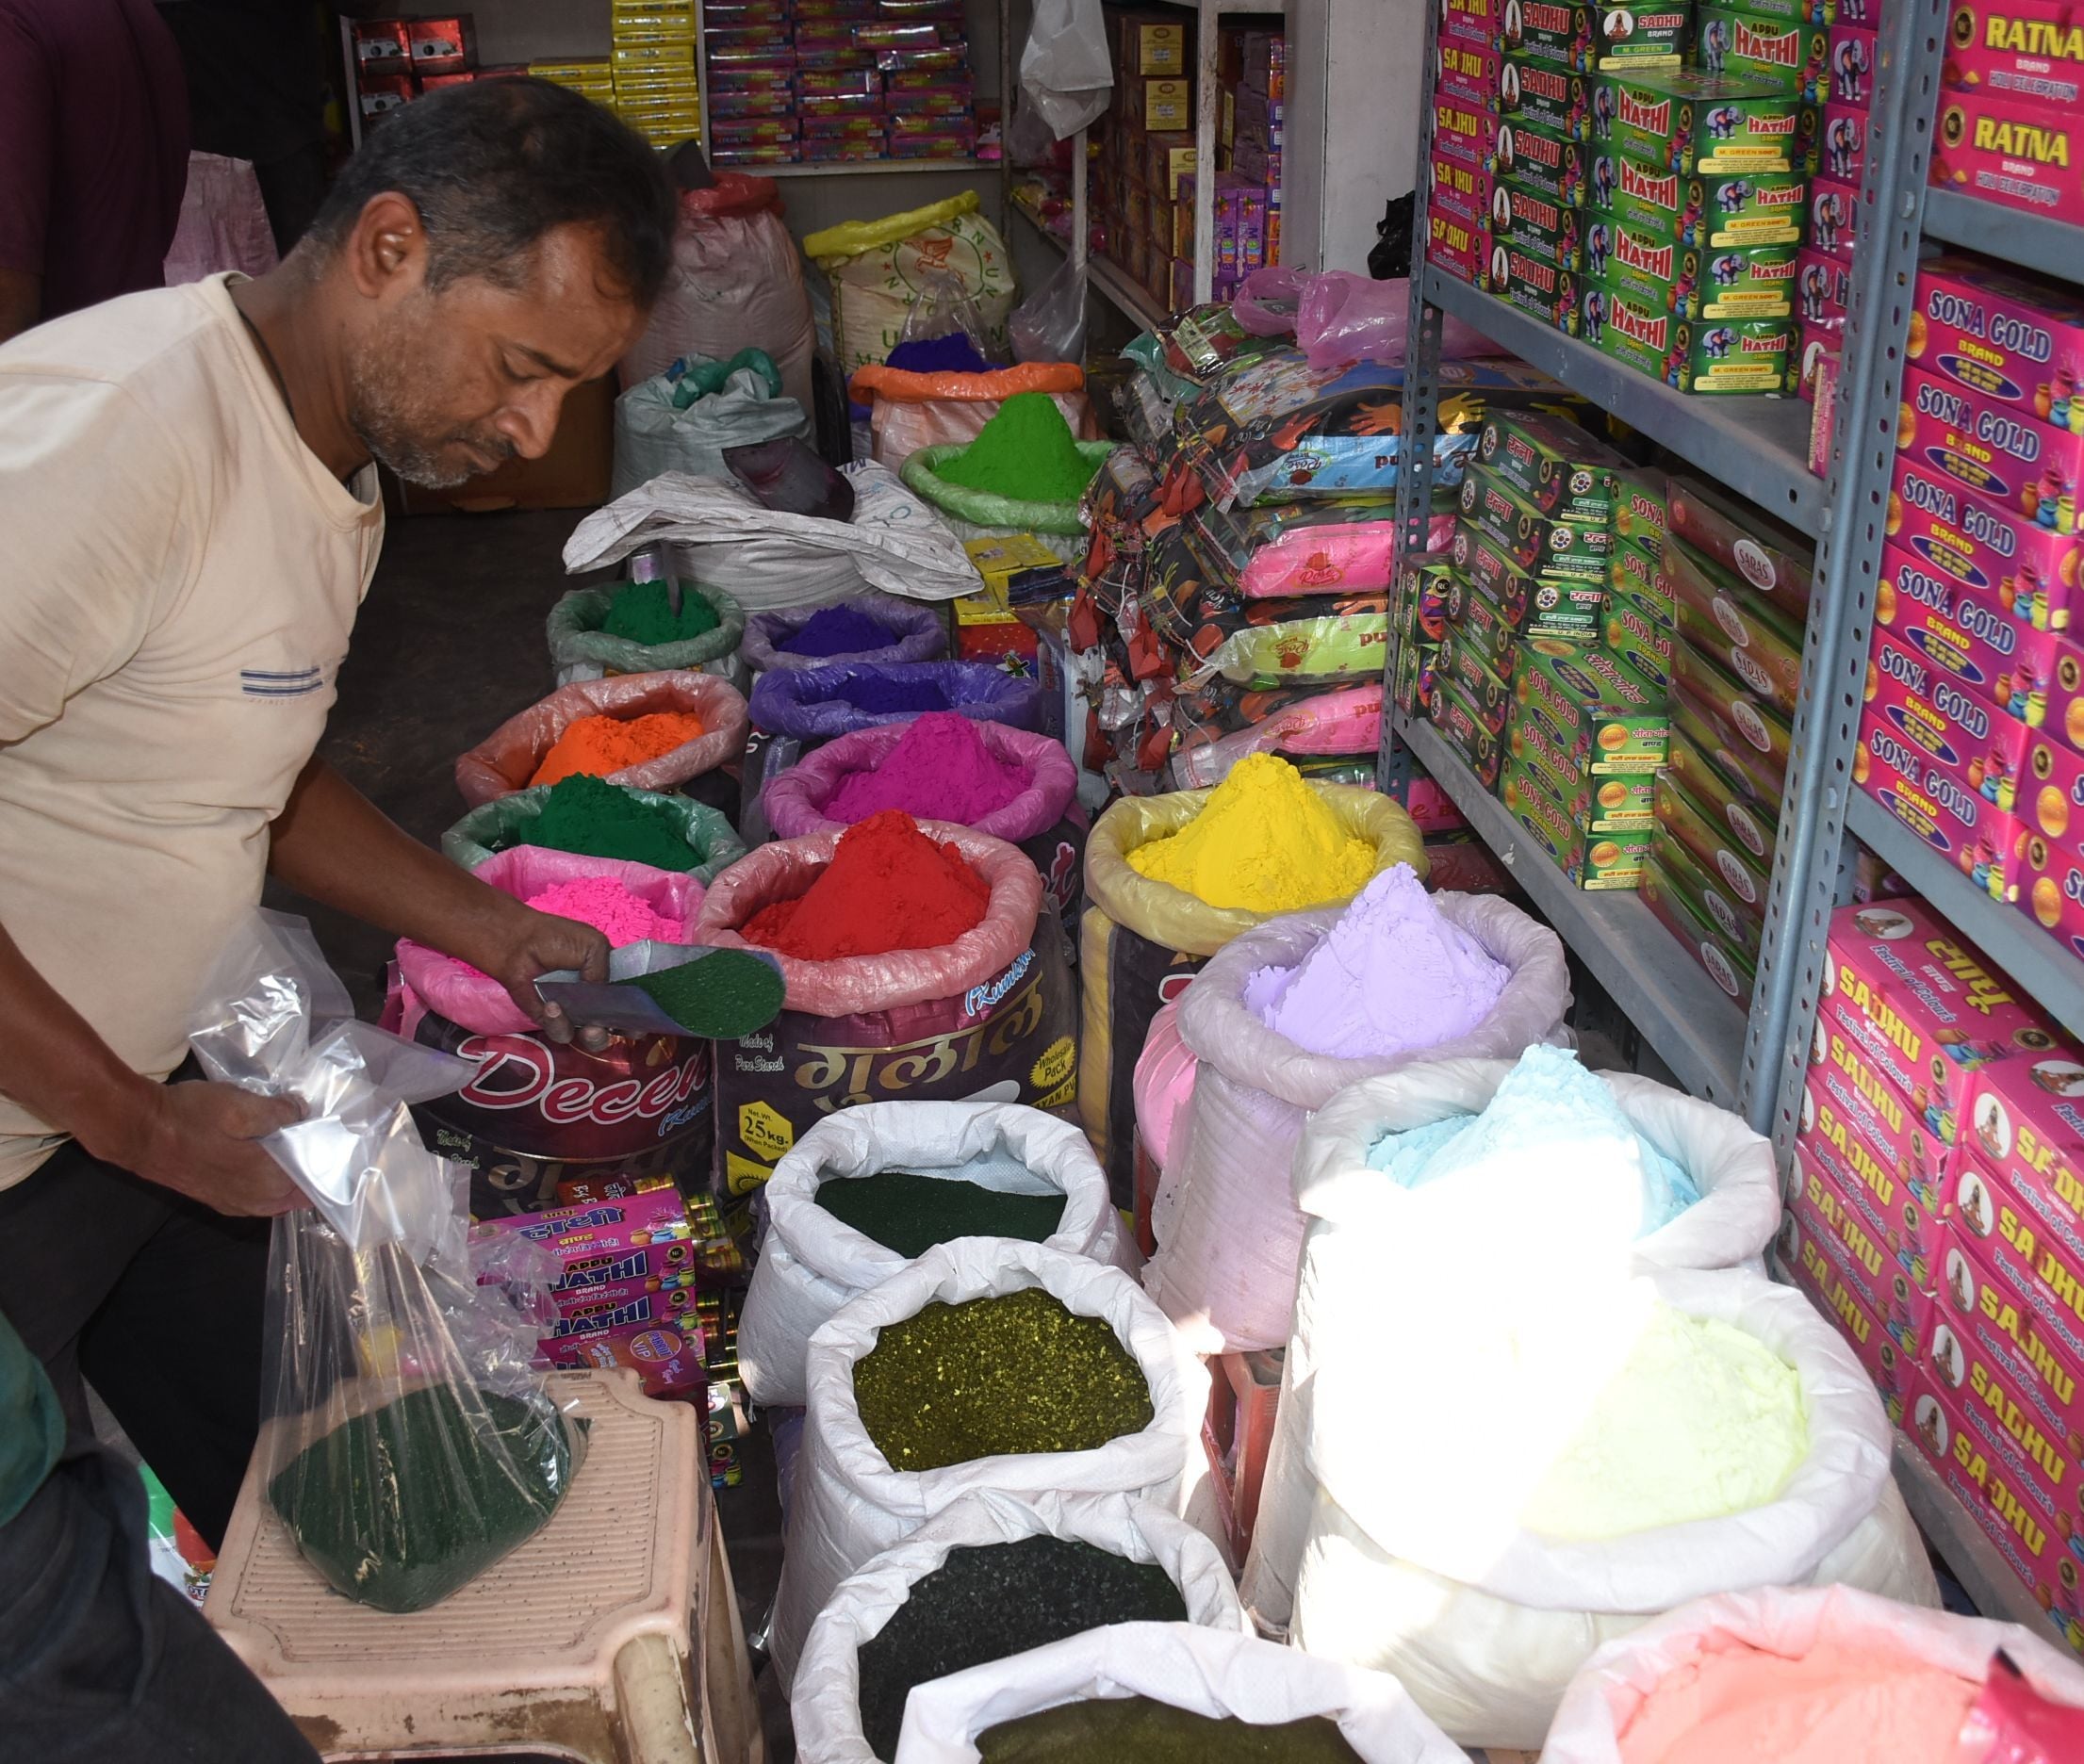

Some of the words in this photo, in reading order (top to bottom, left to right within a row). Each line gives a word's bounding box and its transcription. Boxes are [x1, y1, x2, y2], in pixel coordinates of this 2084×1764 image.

[1523, 2, 1570, 36] SADHU
[1638, 14, 1684, 29] SADHU
[1647, 30, 1674, 39] BRAND
[1733, 18, 1800, 69] HATHI
[1983, 14, 2084, 63] RATNA
[1520, 66, 1567, 103] SADHU
[2015, 58, 2050, 74] BRAND
[1618, 85, 1671, 138] HATHI
[1747, 115, 1796, 135] HATHI
[1514, 129, 1561, 169] SADHU
[1973, 114, 2070, 171] RATNA
[1620, 155, 1678, 212] HATHI
[2000, 160, 2035, 177] BRAND
[1511, 191, 1558, 233] SADHU
[1756, 184, 1804, 206] HATHI
[1615, 224, 1673, 282] HATHI
[1749, 259, 1796, 281] HATHI
[1509, 252, 1555, 294] SADHU
[1611, 292, 1667, 352] HATHI
[1928, 289, 1986, 339] SONA
[1989, 313, 2052, 364] GOLD
[1741, 334, 1787, 353] HATHI
[1958, 339, 2005, 368] BRAND
[1915, 383, 1972, 434] SONA
[1975, 411, 2040, 464] GOLD
[1945, 433, 1992, 464] BAND
[1631, 493, 1666, 530] SONA
[1902, 473, 1958, 526] SONA
[1961, 503, 2016, 558] GOLD
[1928, 522, 1975, 556] BRAND
[1653, 572, 1677, 604] GOL
[1897, 564, 1955, 621] SONA
[1957, 599, 2016, 656] GOLD
[1620, 609, 1653, 647] SONA
[1652, 632, 1674, 662] GOL
[1926, 616, 1971, 650] BRAND
[1527, 664, 1554, 705] SONA
[1551, 690, 1581, 729] GOLD
[1879, 645, 1929, 702] SONA
[1932, 681, 1989, 740] GOLD
[1905, 694, 1946, 732] BRAND
[1521, 719, 1551, 761] SONA
[1551, 747, 1580, 786] GOLD
[1870, 728, 1920, 787] SONA
[1924, 768, 1977, 827] GOLD
[1517, 773, 1544, 812] SONA
[1543, 801, 1572, 841] GOLD
[1895, 780, 1939, 818] BRAND
[1839, 965, 1923, 1064] SADHU
[739, 1034, 763, 1049] Made
[763, 1036, 774, 1053] of
[735, 1054, 755, 1071] Pure
[755, 1055, 785, 1072] Starch
[1043, 1063, 1067, 1082] Pack
[1830, 1034, 1904, 1135] SADHU
[744, 1115, 766, 1138] 25
[766, 1129, 790, 1145] kg.
[744, 1135, 763, 1148] (When
[763, 1138, 789, 1153] Packed)
[2015, 1124, 2084, 1223] SADH
[517, 1205, 625, 1242] हाथी
[575, 1284, 606, 1296] BRAND
[553, 1296, 651, 1340] HATHI
[580, 1328, 610, 1340] BRAND
[632, 1339, 653, 1362] VIP
[1969, 1360, 2067, 1486] SADHU
